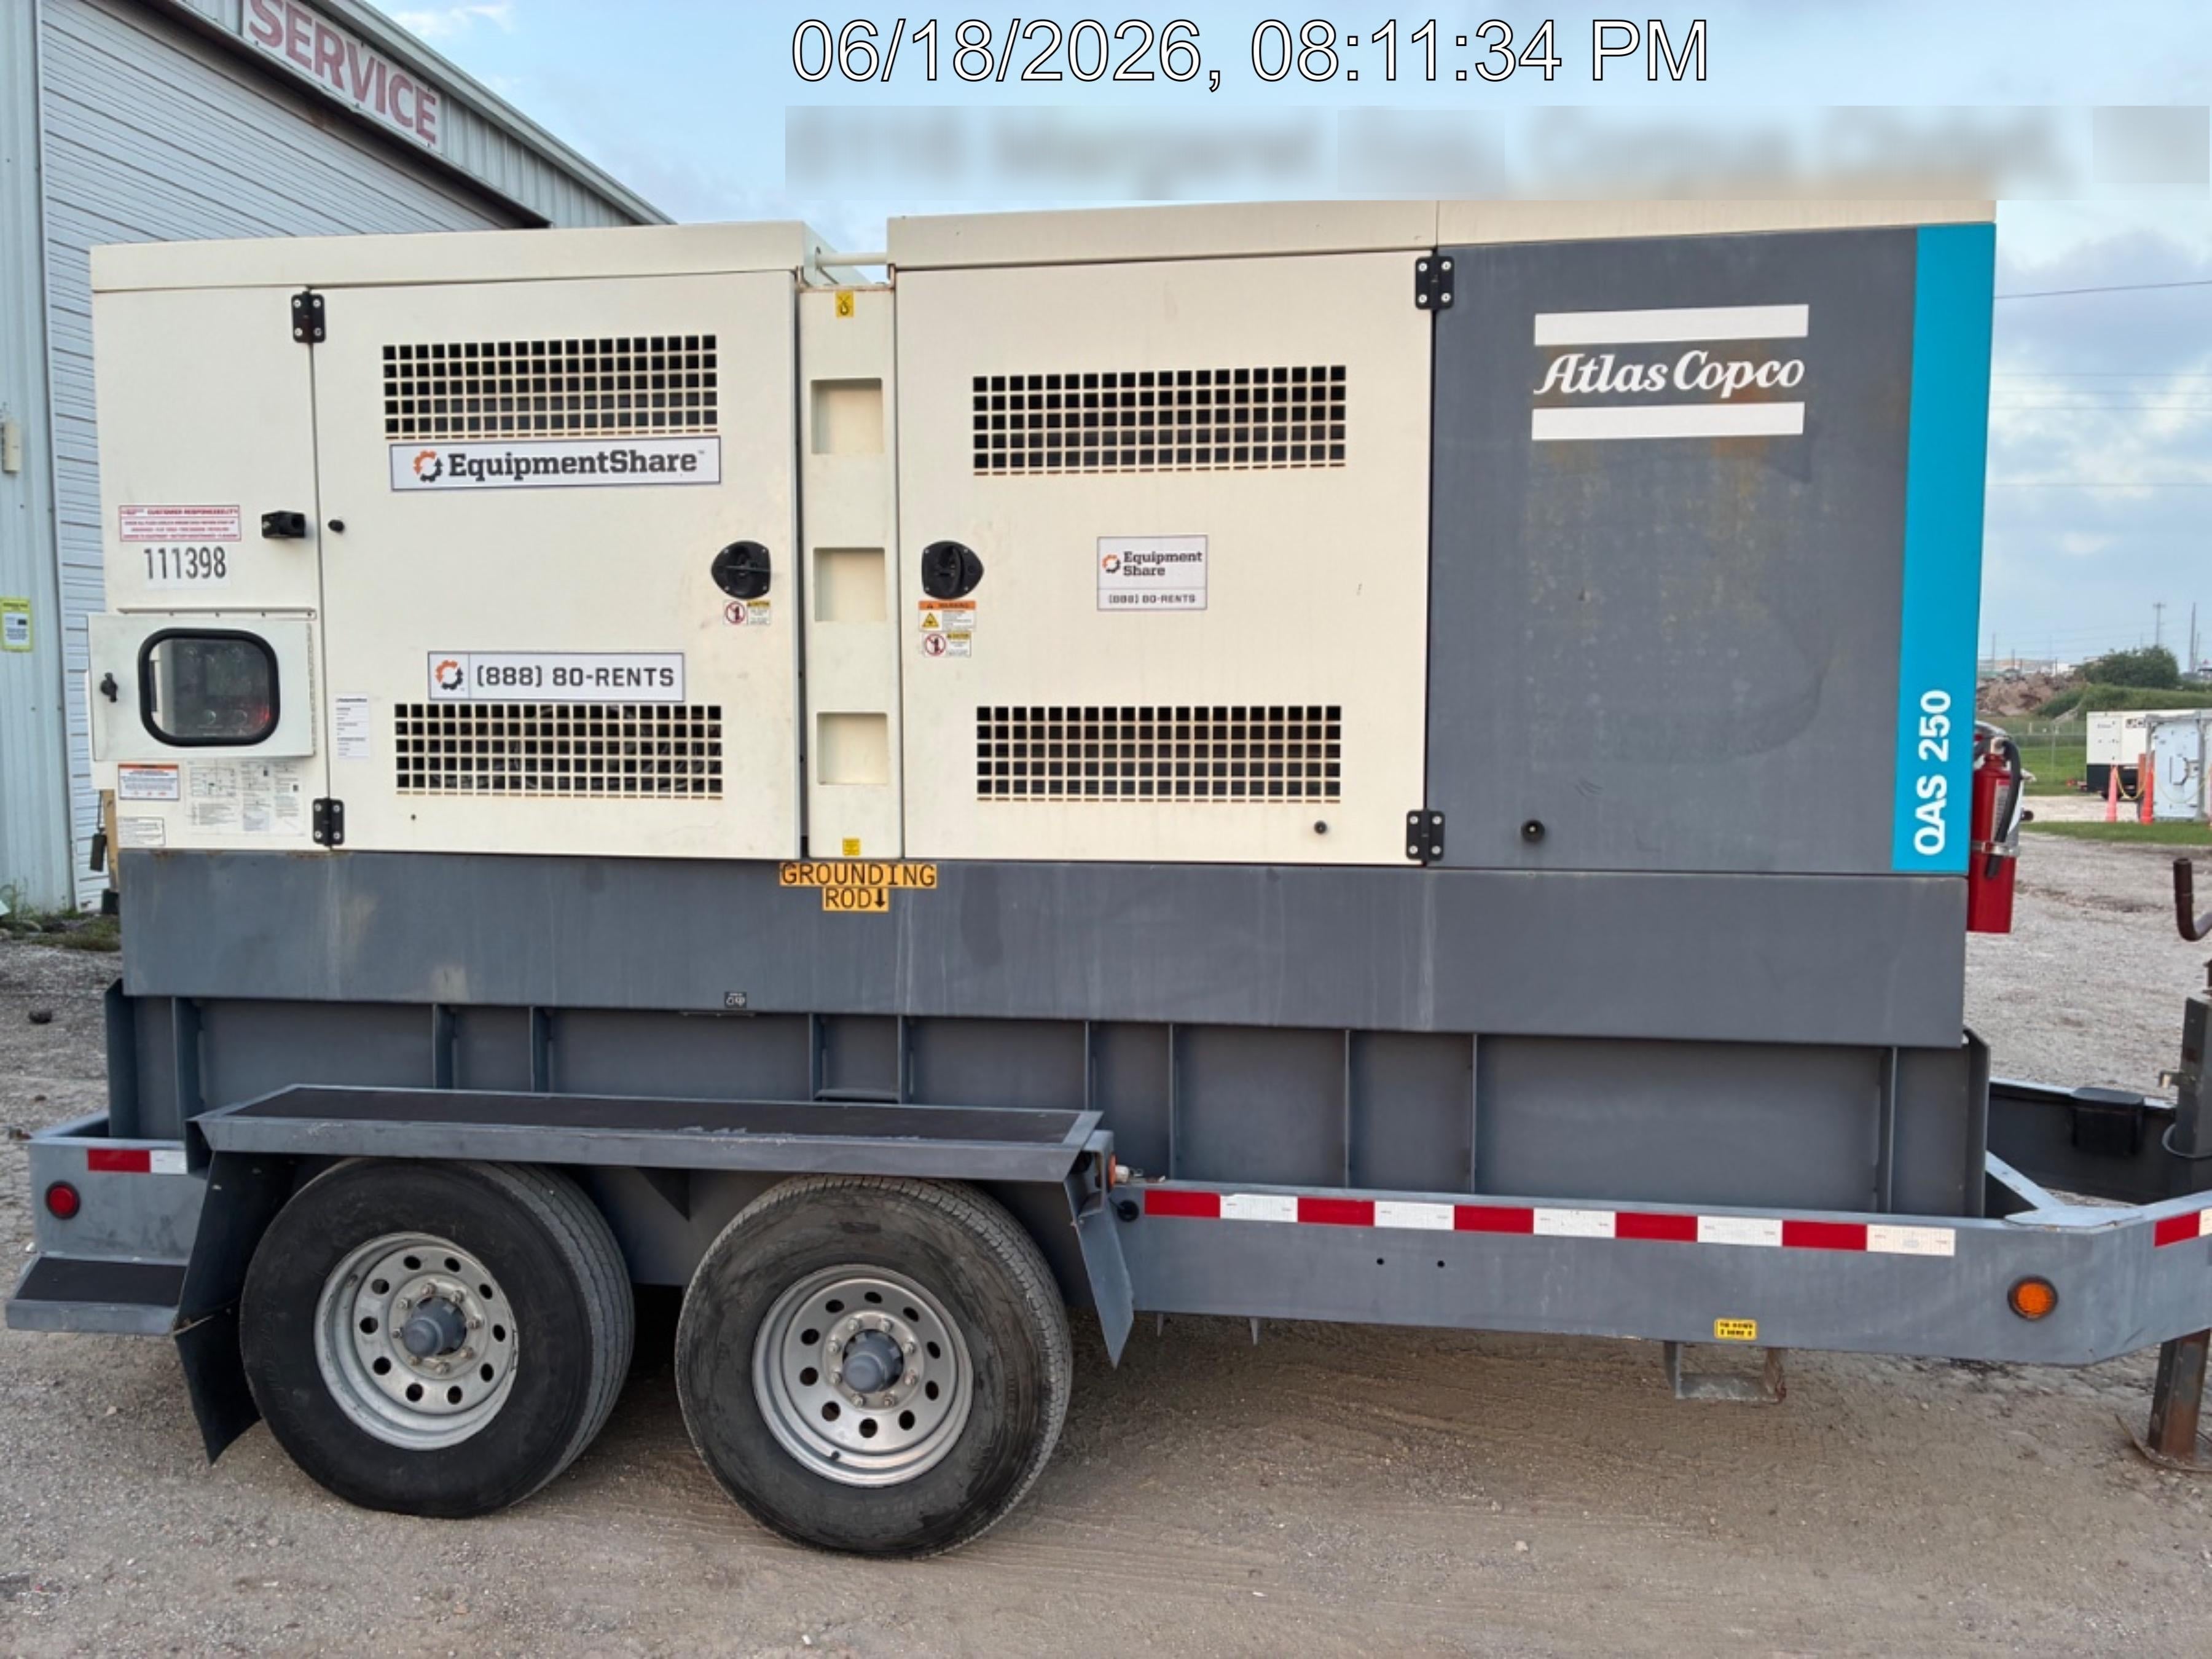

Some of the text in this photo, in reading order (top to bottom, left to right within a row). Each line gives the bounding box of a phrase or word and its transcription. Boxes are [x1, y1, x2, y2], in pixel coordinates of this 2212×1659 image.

[249, 0, 436, 144] SERVICE
[1534, 350, 1805, 399] Atlas Copco
[448, 449, 697, 482] EquipmentShare
[143, 545, 227, 579] 111398
[1123, 551, 1203, 565] Equipment
[1123, 565, 1166, 576] Share
[477, 665, 675, 688] (888) 80-RENTS
[1914, 690, 1951, 855] QAS 250
[782, 863, 936, 887] GROUNDING
[825, 888, 873, 909] ROD
